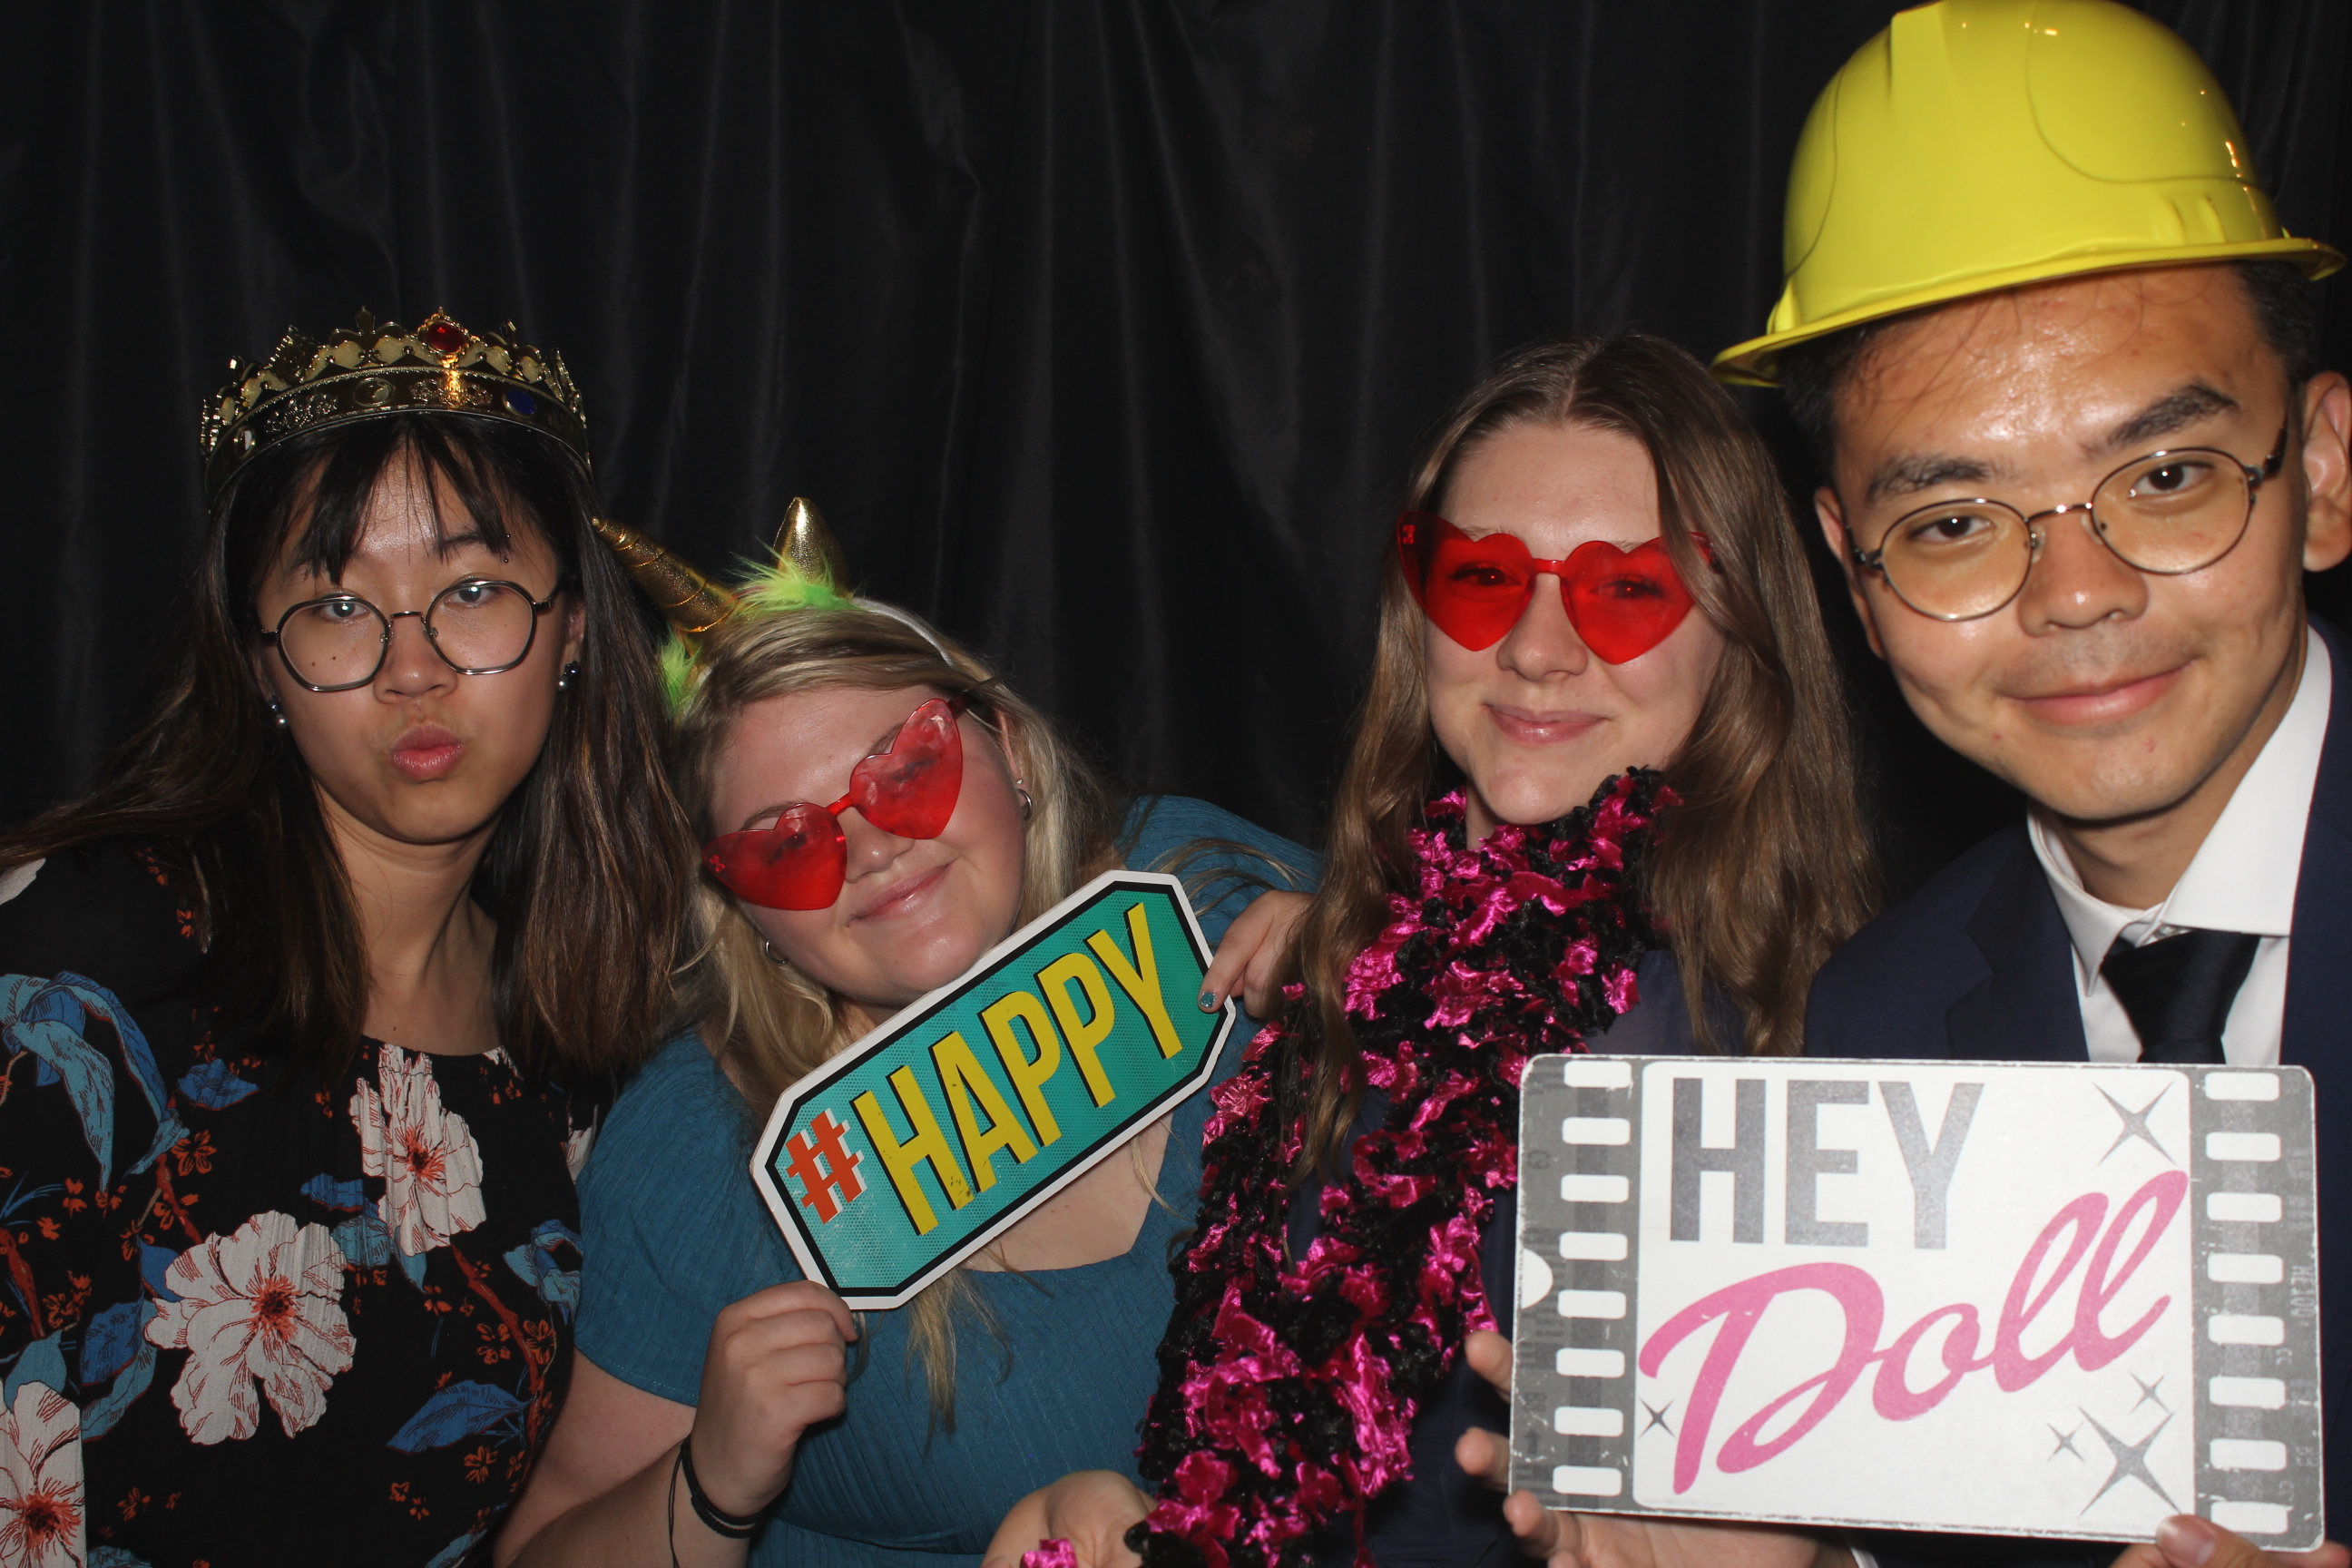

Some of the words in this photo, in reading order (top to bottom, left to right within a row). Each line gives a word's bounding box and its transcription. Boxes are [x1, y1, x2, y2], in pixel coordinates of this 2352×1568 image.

[785, 901, 1183, 1236] #HAPPY
[1670, 1077, 1985, 1250] HEY
[1638, 1170, 2189, 1495] Doll
